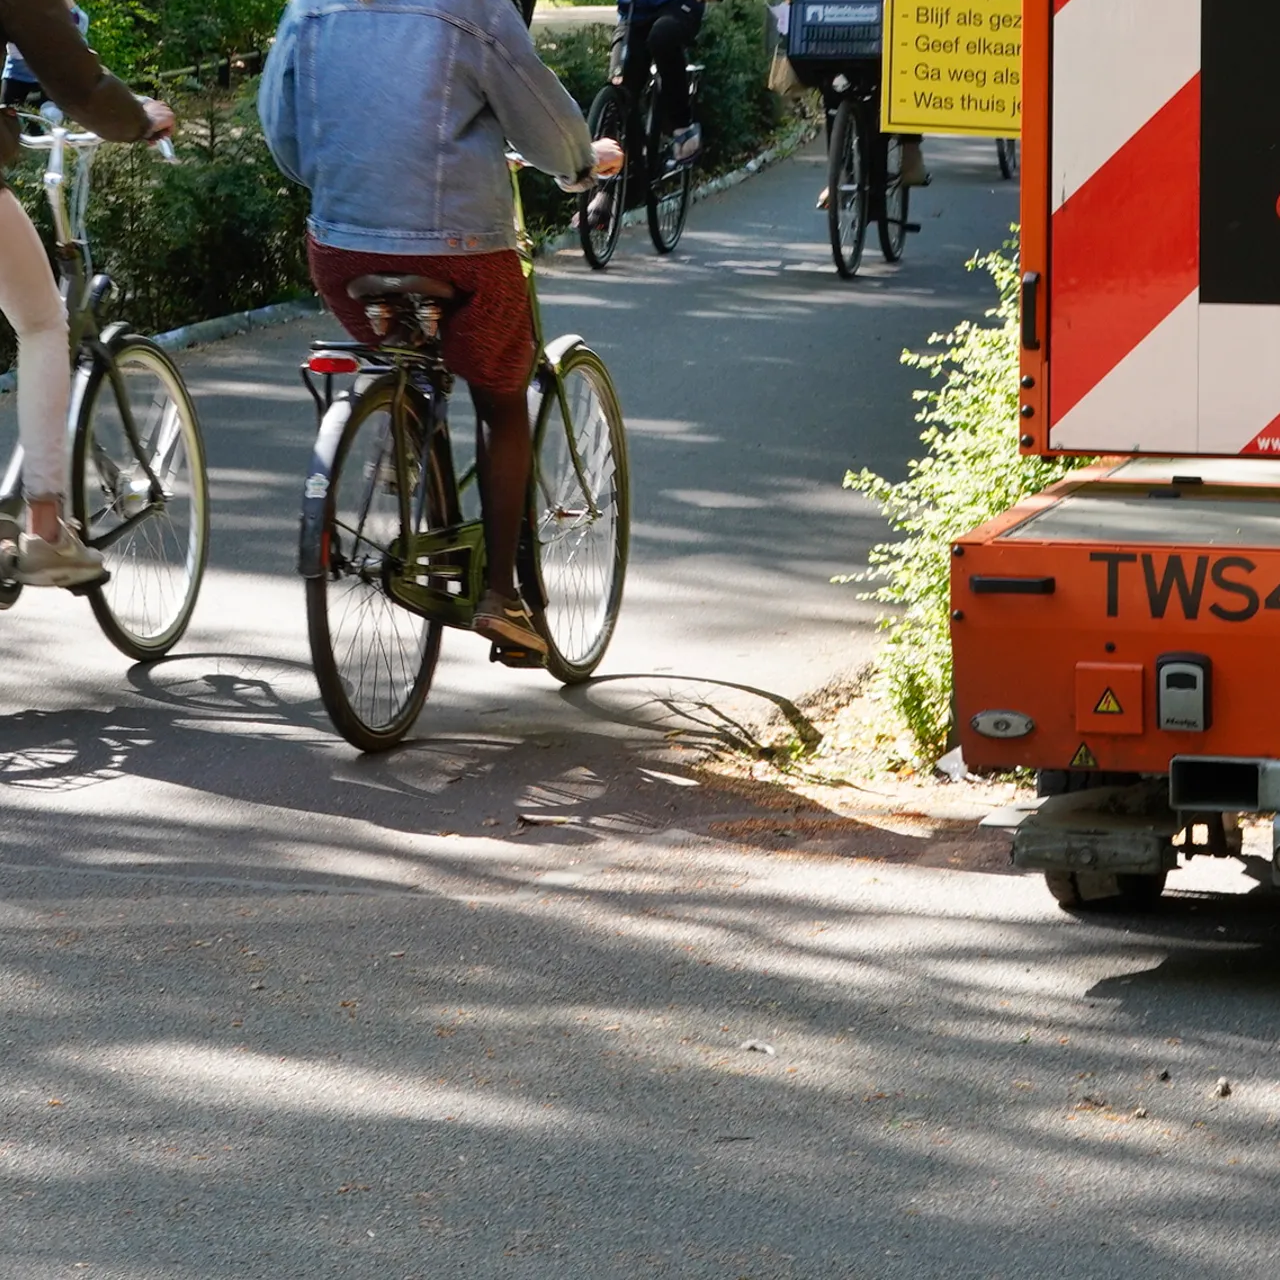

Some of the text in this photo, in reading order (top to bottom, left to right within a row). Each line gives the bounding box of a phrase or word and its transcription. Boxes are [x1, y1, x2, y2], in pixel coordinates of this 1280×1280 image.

[915, 6, 1022, 32] Blijf als gez
[914, 34, 1022, 57] Geef elkaar
[914, 62, 1020, 88] Ga weg als
[913, 91, 954, 110] Was
[960, 94, 1006, 114] thuis
